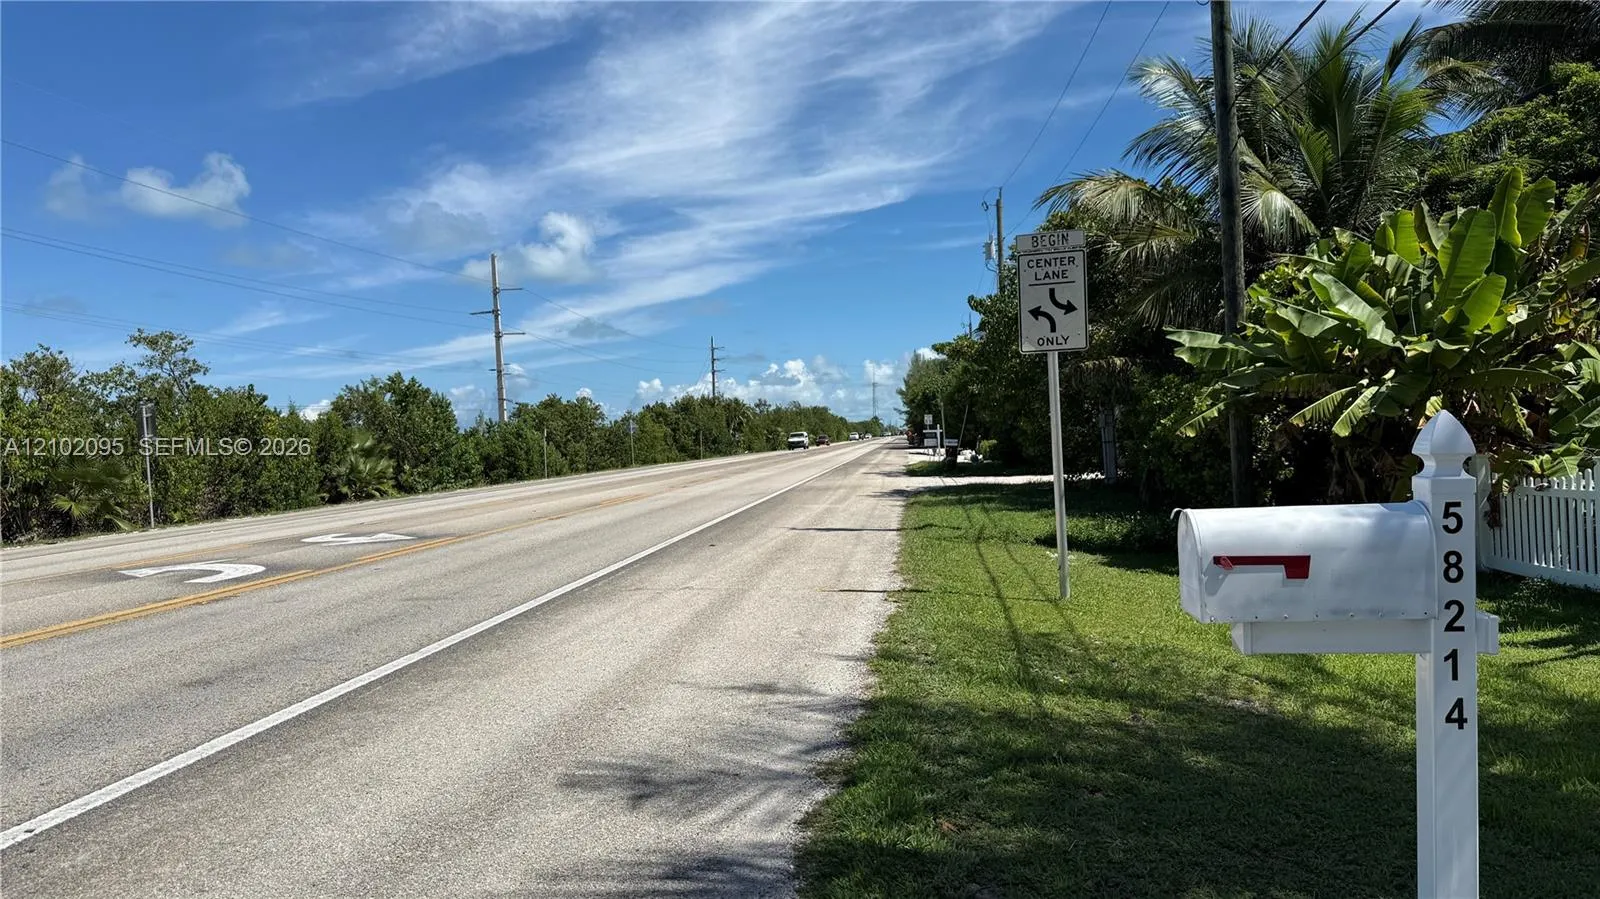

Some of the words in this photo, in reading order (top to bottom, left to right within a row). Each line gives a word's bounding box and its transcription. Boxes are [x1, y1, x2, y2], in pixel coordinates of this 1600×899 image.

[1031, 233, 1069, 248] BEGIN
[1027, 256, 1076, 269] CENTER
[1034, 270, 1069, 281] LANE
[1037, 336, 1070, 347] ONLY
[1441, 501, 1468, 730] 58214
